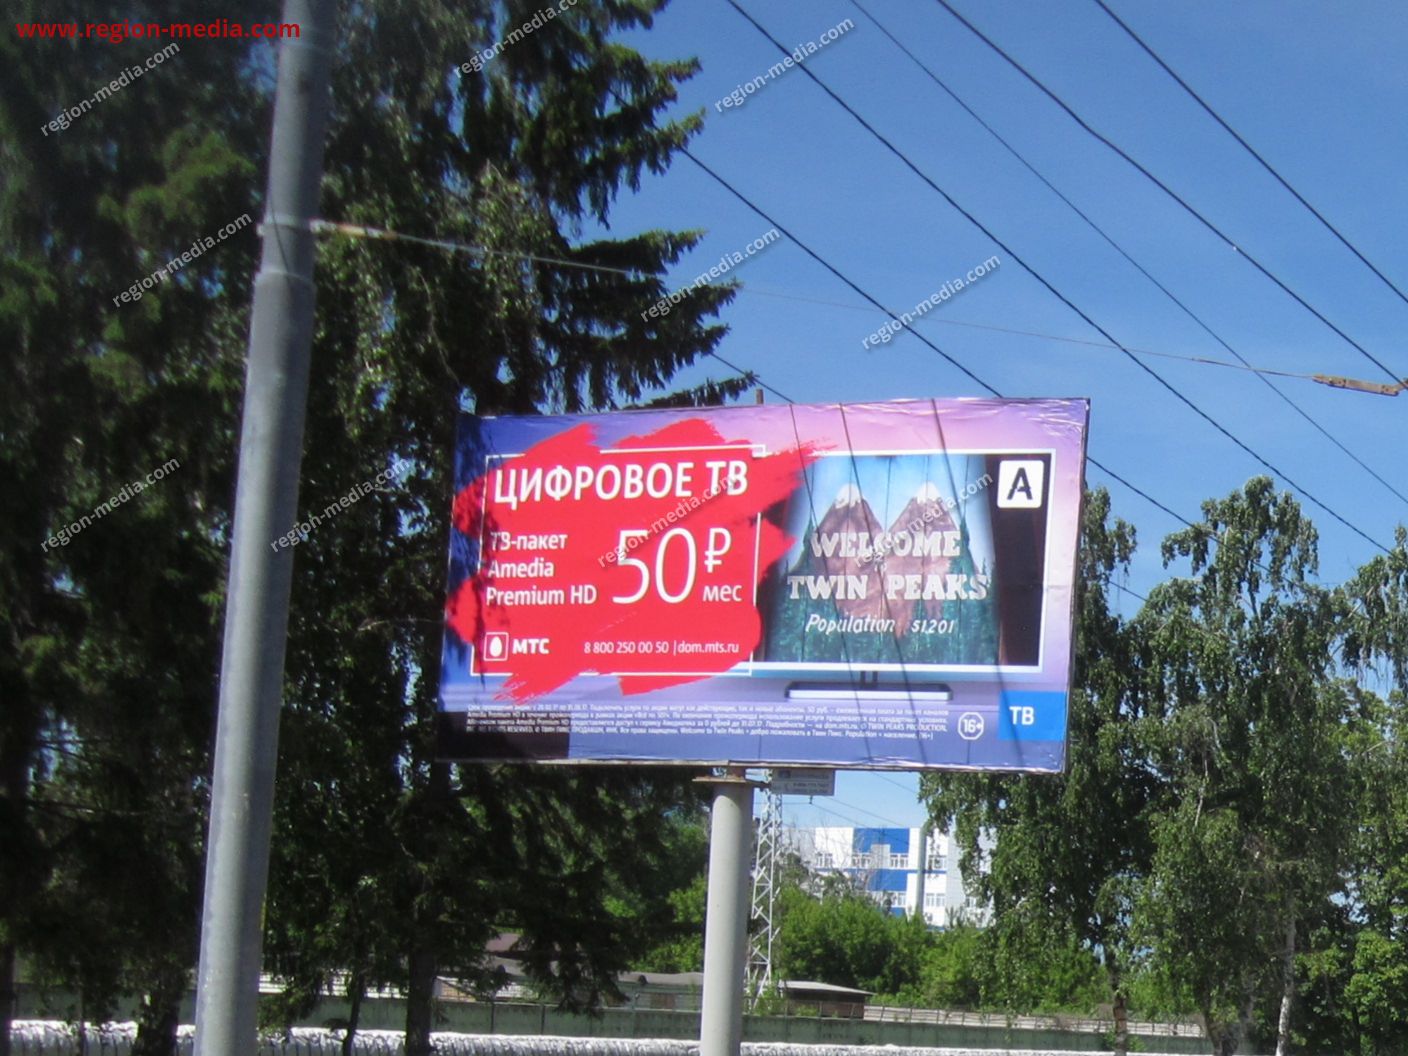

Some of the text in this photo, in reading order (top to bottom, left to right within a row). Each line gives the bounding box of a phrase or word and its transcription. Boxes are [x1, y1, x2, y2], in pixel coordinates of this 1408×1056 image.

[494, 460, 747, 510] ЦИФРОВОЕ ТВ
[490, 532, 567, 551] ТВ-пакет
[812, 530, 961, 557] WELCOME
[488, 558, 554, 578] Amedia
[485, 584, 597, 606] Premium HD
[702, 584, 742, 602] мес
[787, 574, 987, 600] TWIN PEAKS
[805, 614, 895, 635] Population
[512, 638, 550, 655] МТС
[583, 642, 591, 653] 8
[592, 642, 614, 653] 800
[616, 642, 636, 653] 250
[637, 642, 654, 653] 00
[655, 642, 669, 654] 50
[962, 716, 982, 734] 16+
[1009, 706, 1035, 725] ТВ
